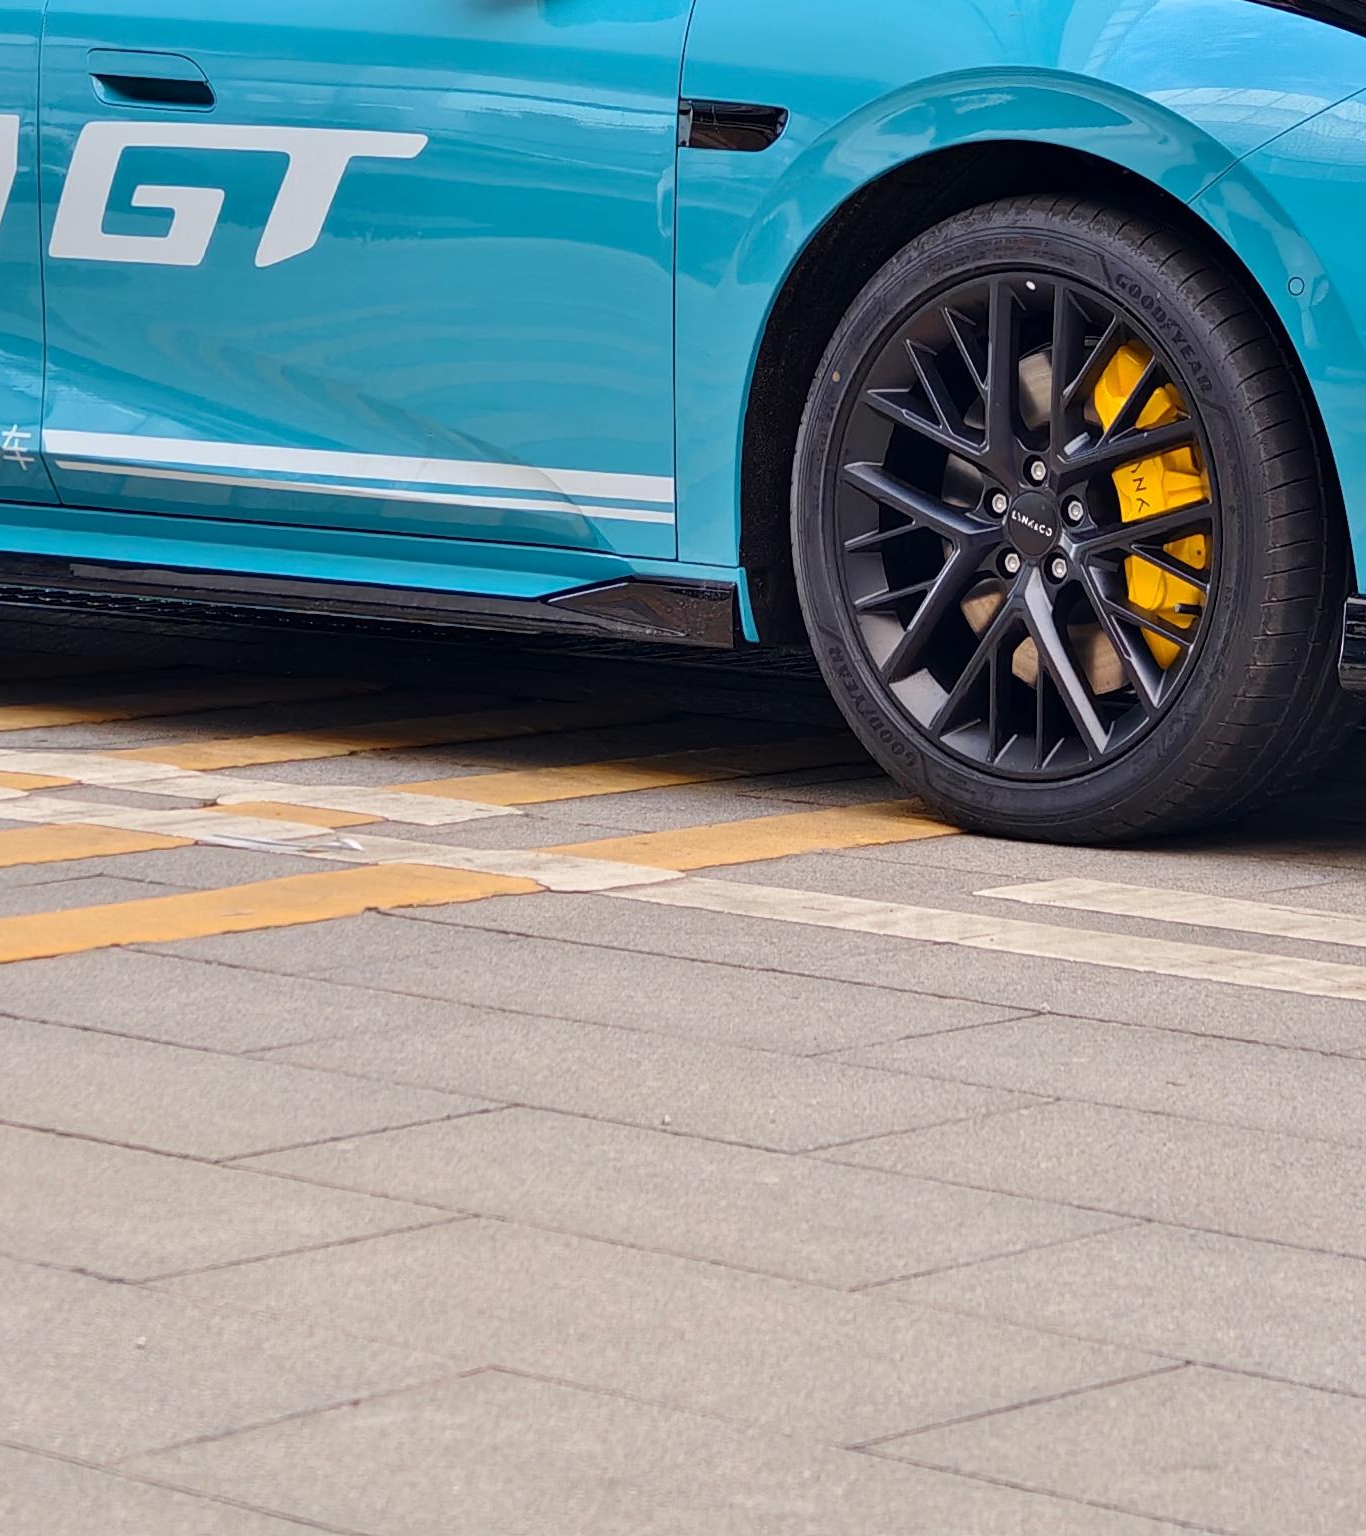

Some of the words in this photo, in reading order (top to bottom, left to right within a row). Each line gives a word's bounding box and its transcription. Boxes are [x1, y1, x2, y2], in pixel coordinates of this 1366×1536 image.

[48, 121, 429, 267] GT
[1116, 273, 1213, 393] GOODYEAR
[1011, 510, 1053, 537] LYNK&CO
